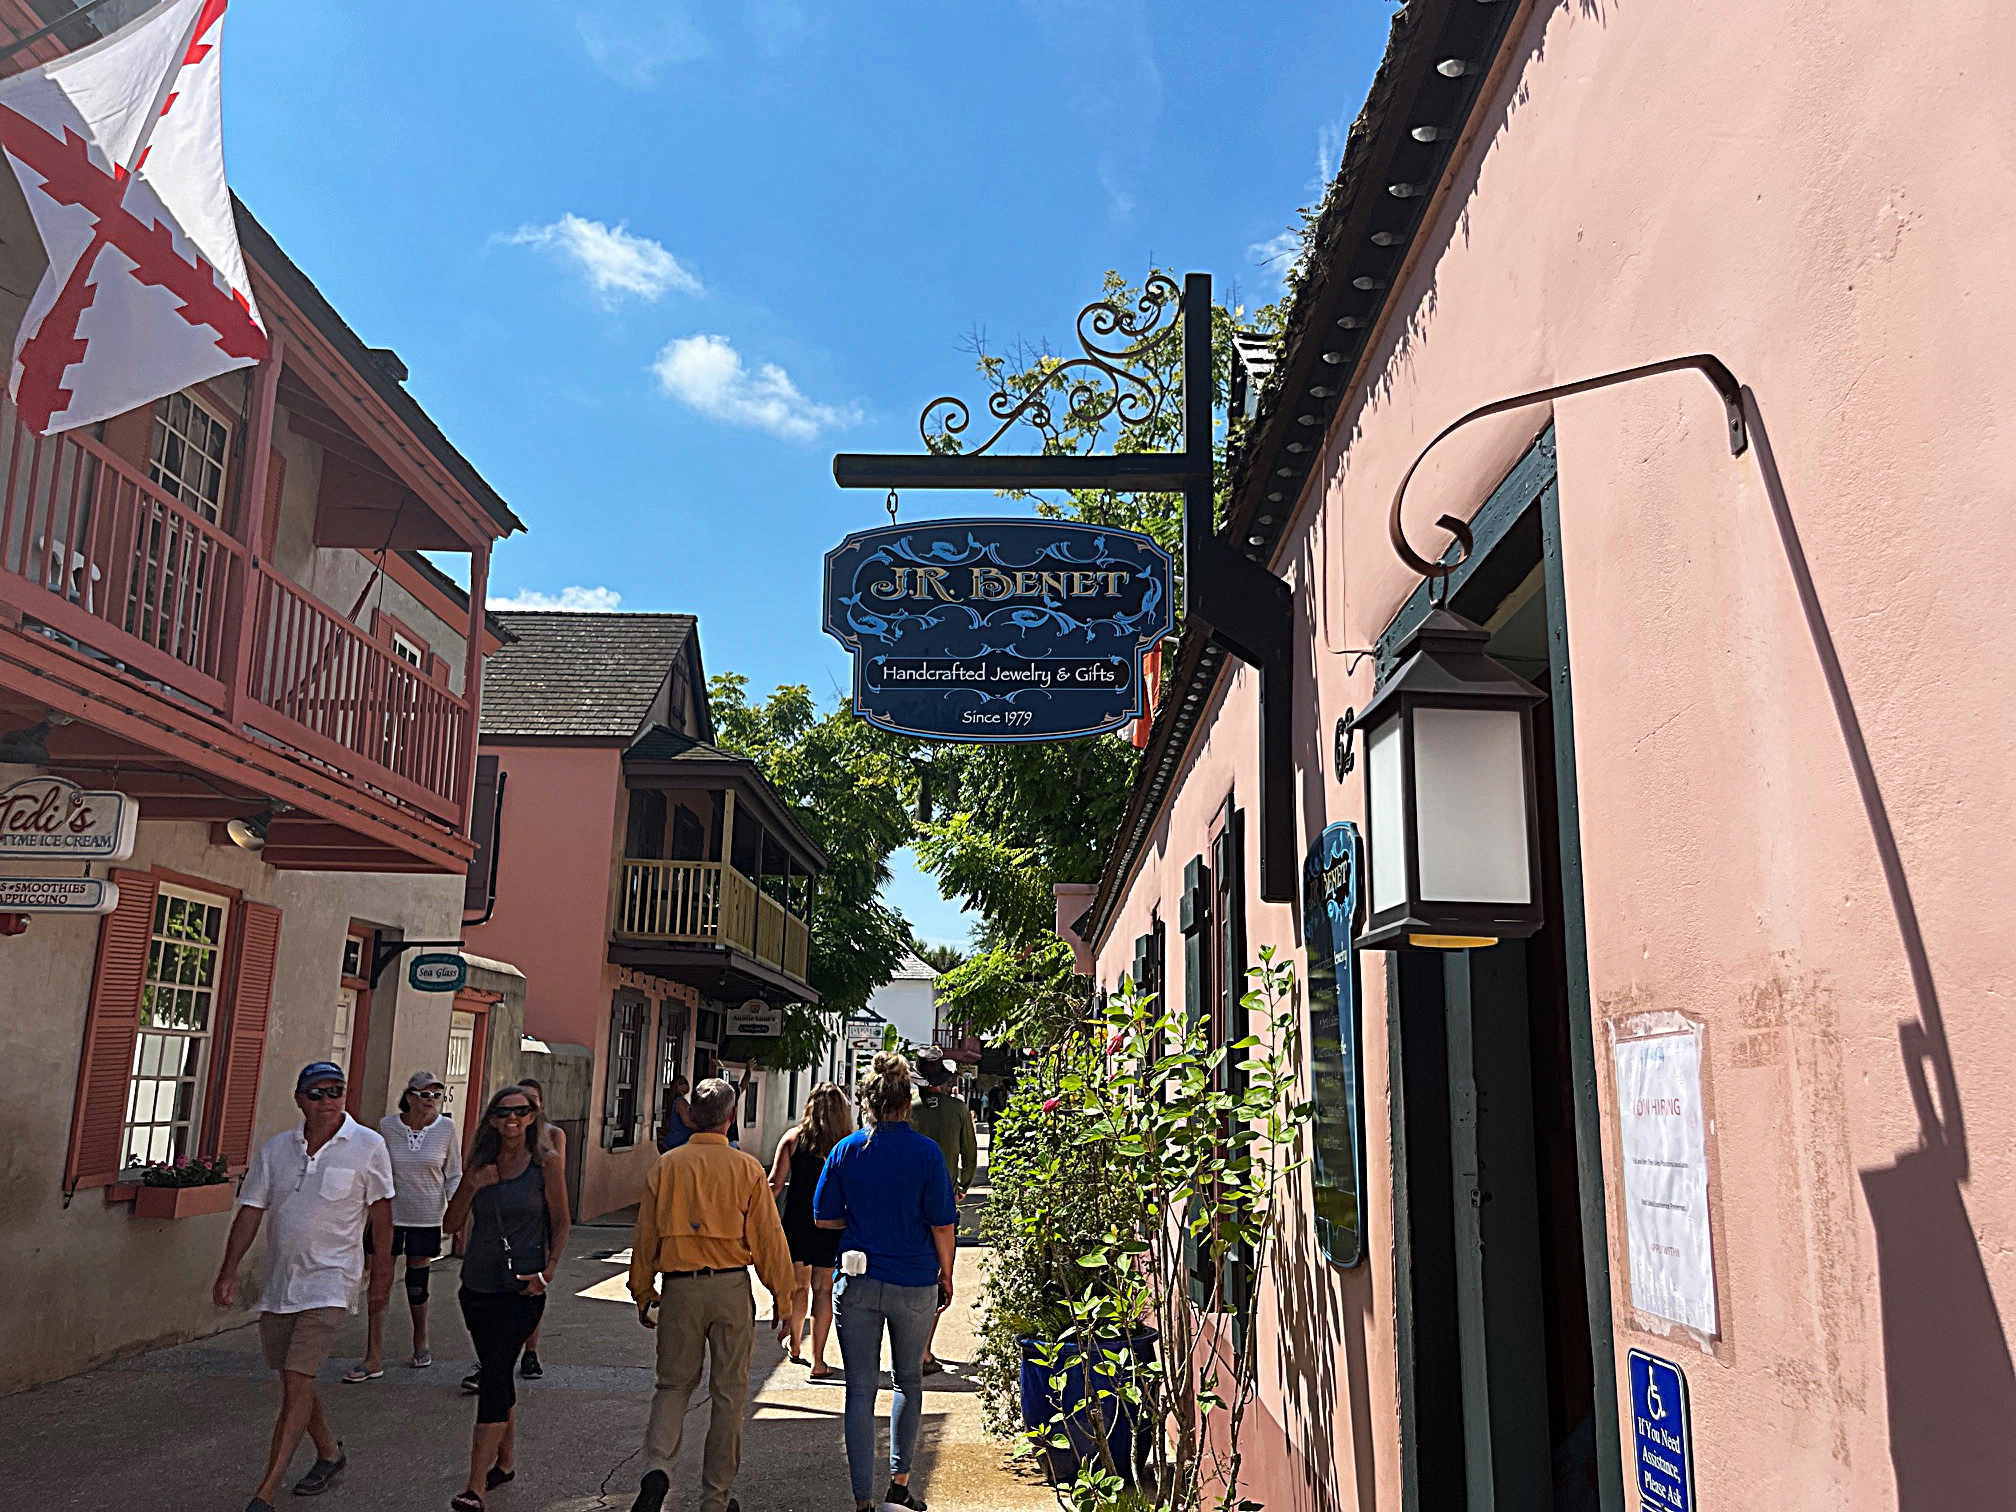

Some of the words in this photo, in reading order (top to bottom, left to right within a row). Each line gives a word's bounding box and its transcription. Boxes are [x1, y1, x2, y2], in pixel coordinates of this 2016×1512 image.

[870, 566, 964, 602] J.R.
[968, 566, 1131, 601] BENET
[882, 662, 986, 682] Handcrafted
[990, 662, 1051, 688] Jewelry
[1056, 667, 1070, 681] &
[1075, 664, 1115, 682] Gifts
[961, 710, 1001, 725] Since
[1004, 710, 1033, 726] 1979
[3, 833, 37, 847] TYME
[39, 834, 62, 847] ICE
[65, 836, 112, 848] CREAM
[418, 967, 433, 977] Sea
[435, 966, 457, 979] Glass
[1637, 1416, 1645, 1436] If
[1643, 1419, 1661, 1444] You
[1660, 1427, 1681, 1454] Need
[1642, 1445, 1681, 1484] Assistance,
[1643, 1469, 1667, 1499] Please
[1667, 1484, 1683, 1509] Ask
